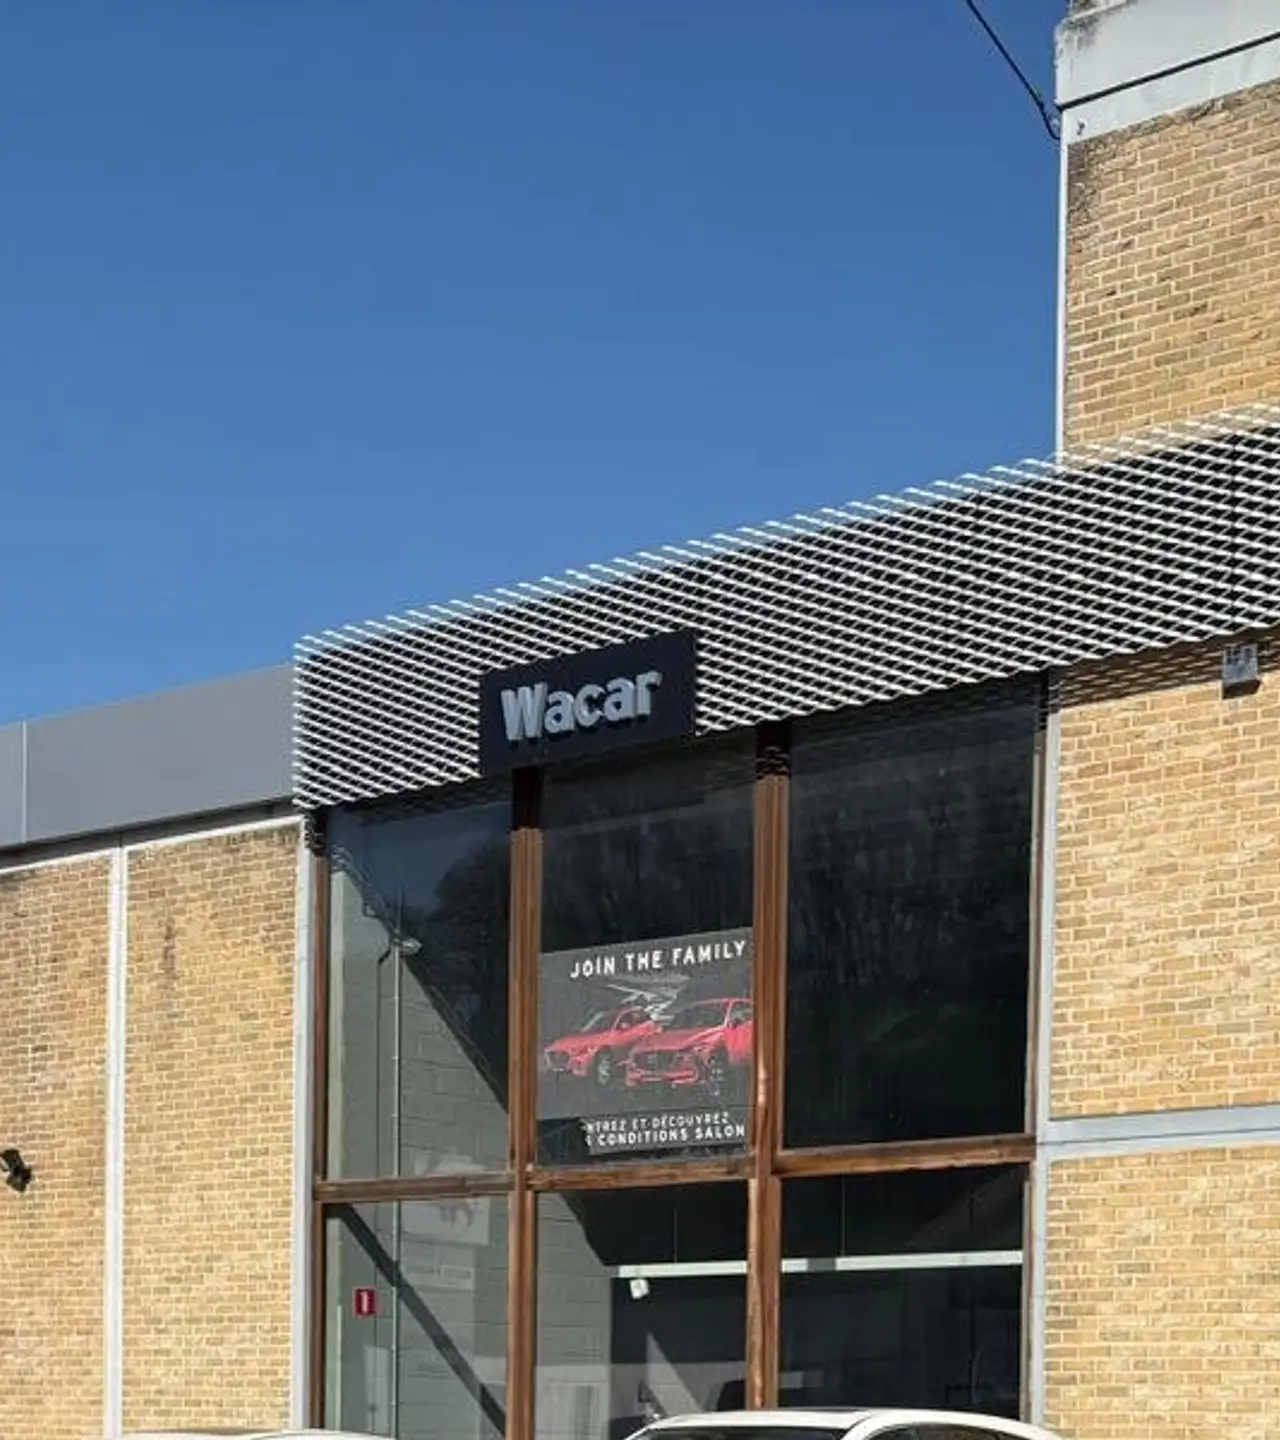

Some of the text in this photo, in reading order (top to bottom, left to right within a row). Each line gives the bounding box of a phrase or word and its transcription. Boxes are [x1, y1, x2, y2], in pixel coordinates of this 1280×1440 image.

[500, 670, 663, 741] Wacar
[570, 939, 746, 979] JOIN THE FAMILY
[597, 1127, 687, 1147] CONDITIONS
[695, 1124, 745, 1140] SALON
